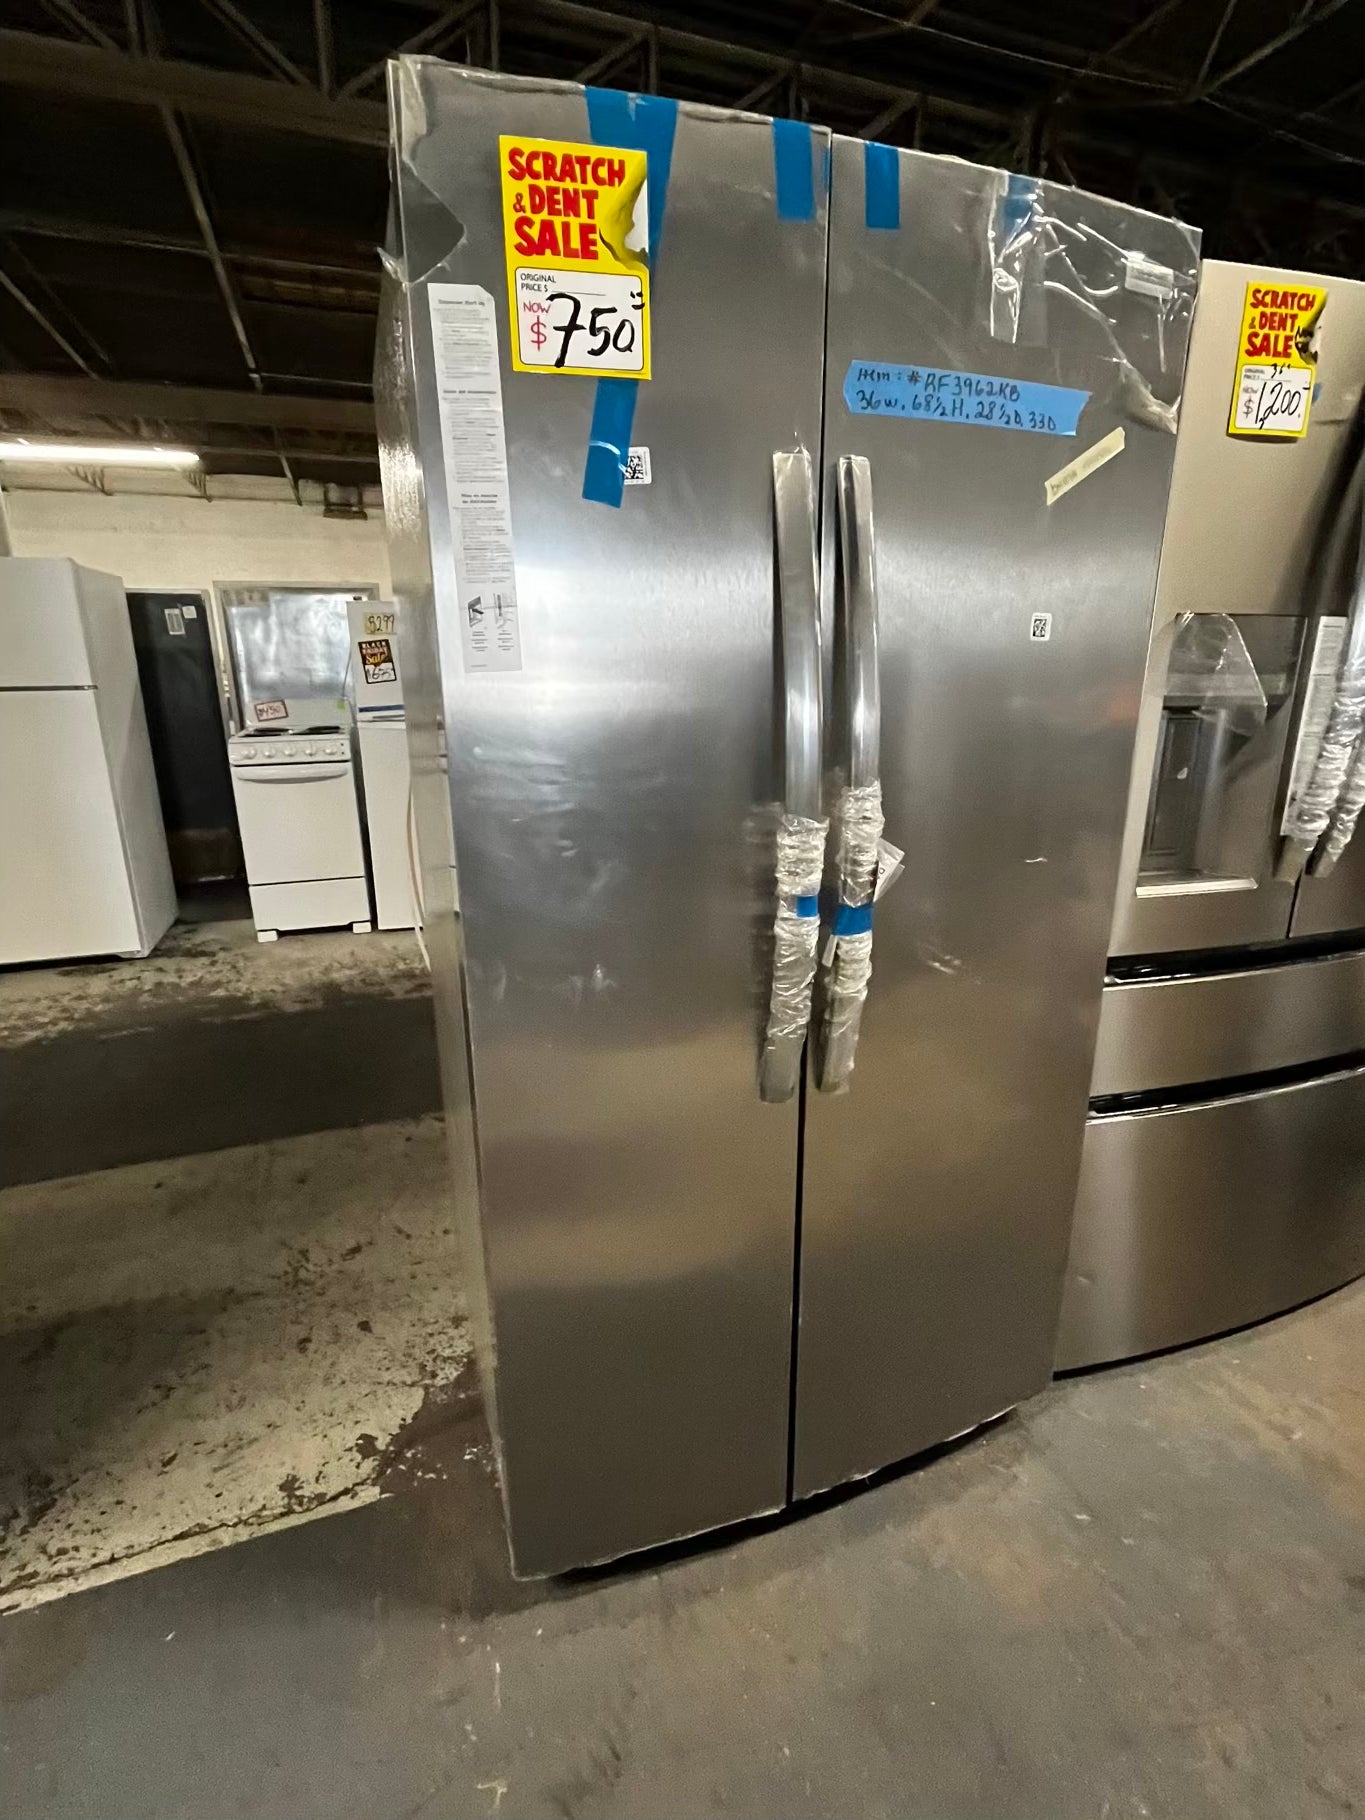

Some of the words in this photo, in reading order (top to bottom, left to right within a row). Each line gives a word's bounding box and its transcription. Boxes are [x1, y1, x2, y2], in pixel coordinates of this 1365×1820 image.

[508, 146, 626, 188] SCRATCH
[513, 192, 526, 214] &
[528, 184, 599, 220] DENT
[513, 216, 599, 261] SALE
[520, 272, 557, 285] ORIGINAL
[520, 282, 542, 293] PRICE
[523, 301, 551, 314] NOW
[1250, 288, 1316, 312] SCRATCH
[1258, 311, 1299, 333] DENT
[1245, 331, 1294, 359] SALE
